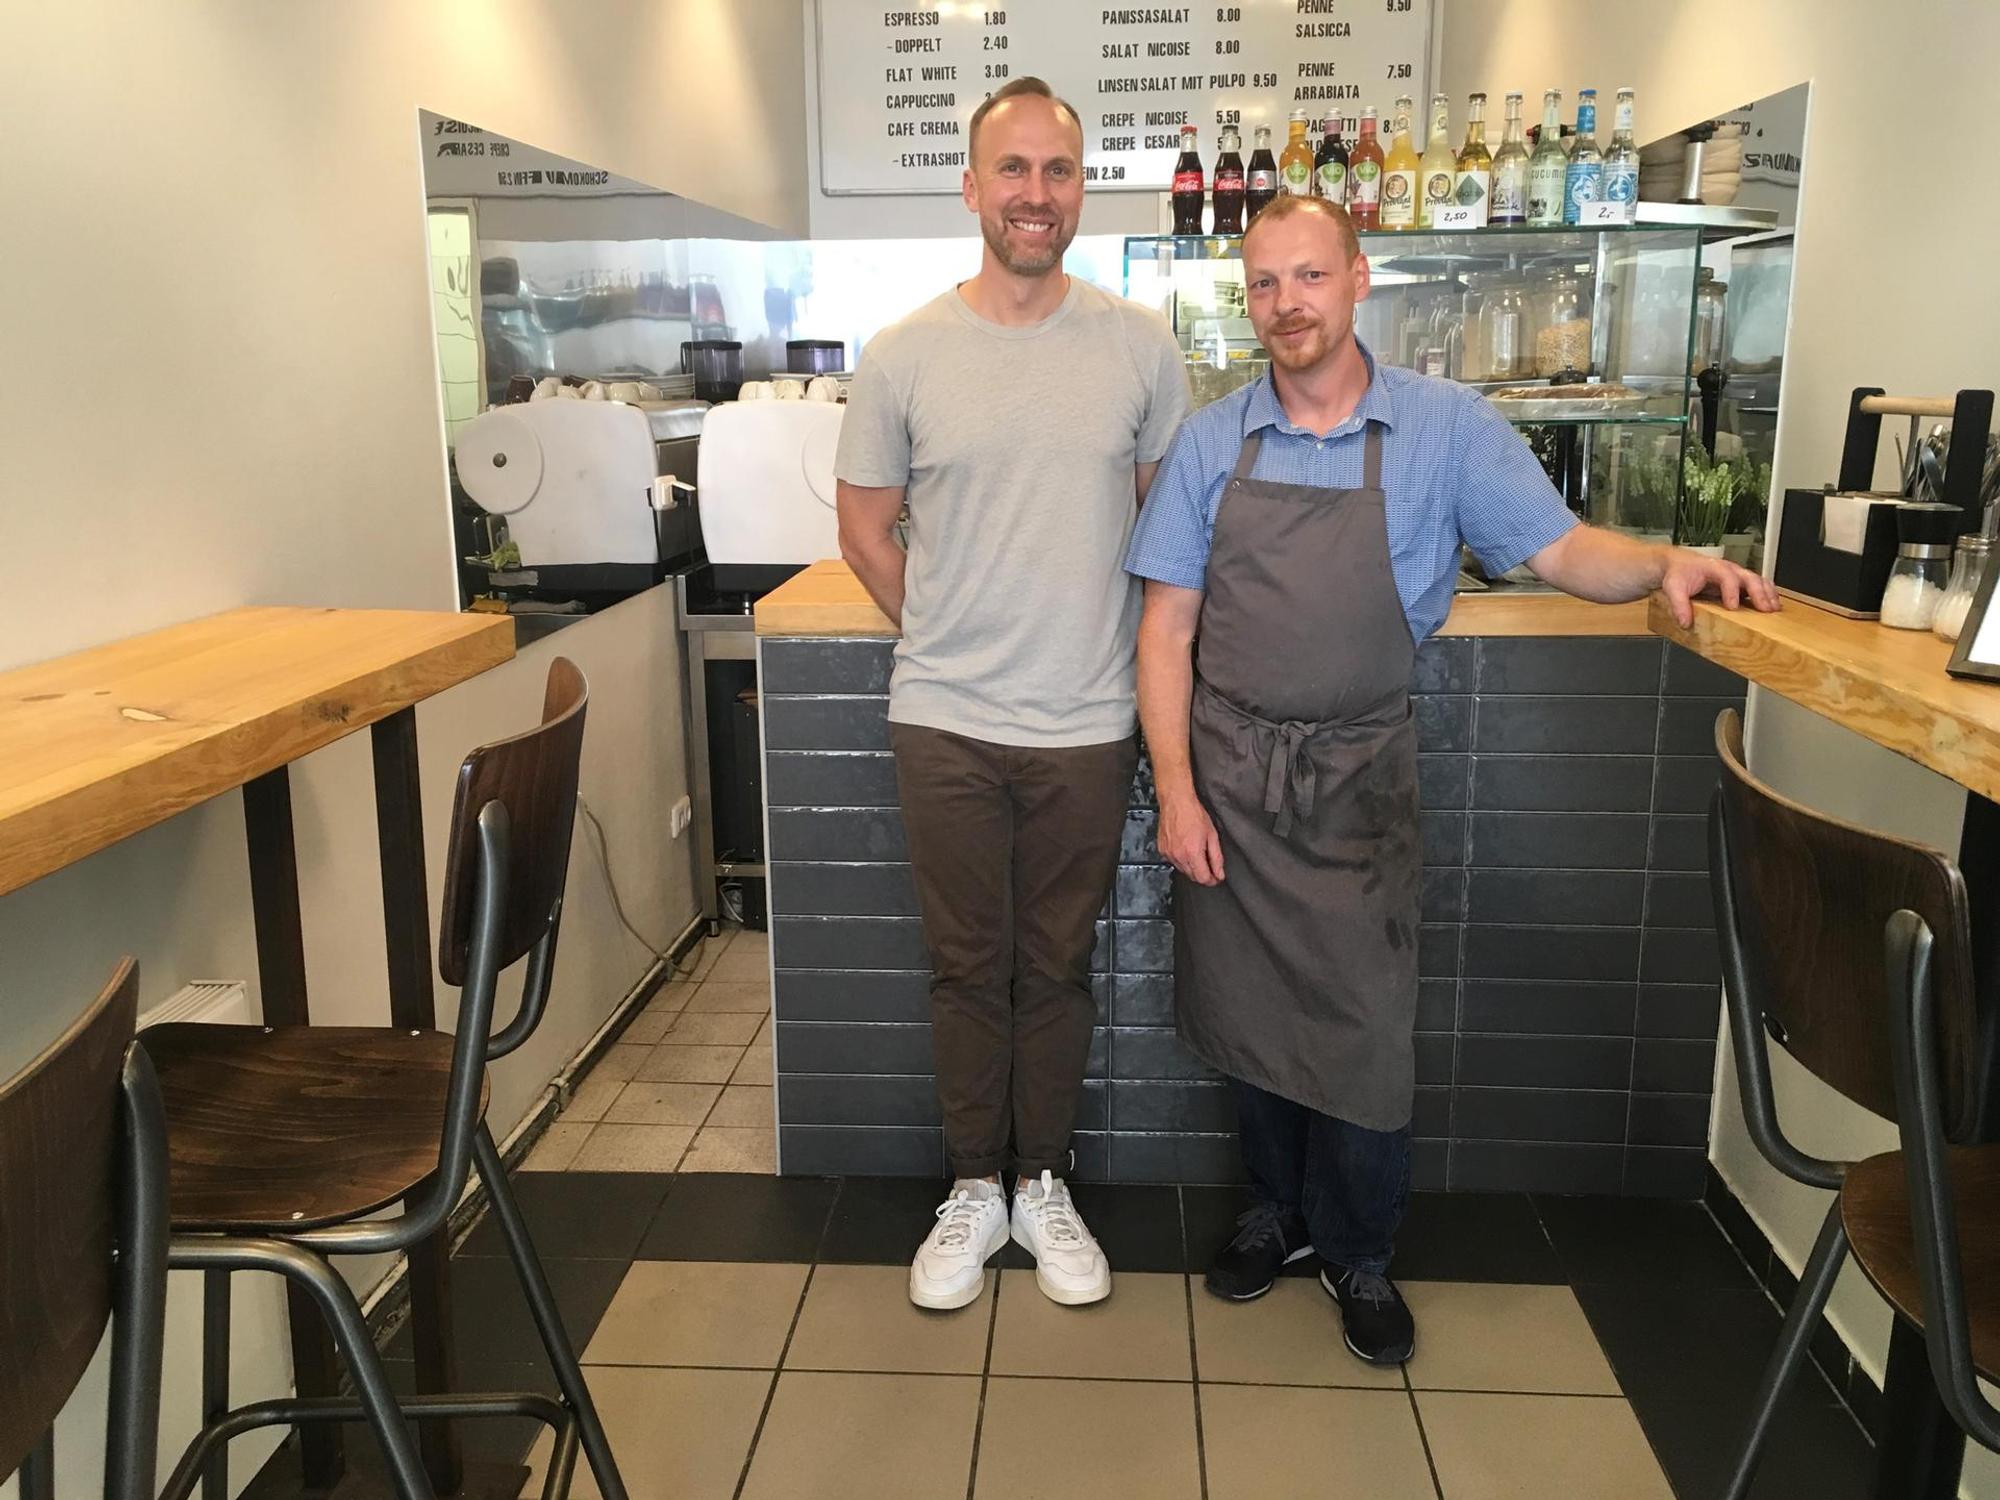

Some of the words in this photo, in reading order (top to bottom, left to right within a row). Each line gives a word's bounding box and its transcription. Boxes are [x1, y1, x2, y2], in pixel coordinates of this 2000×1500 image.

[1297, 0, 1334, 14] PENNE
[1387, 0, 1411, 12] 9.50
[884, 11, 940, 27] ESPRESSO
[984, 11, 1006, 26] 1.80
[1102, 8, 1190, 25] PANISSASALAT
[1216, 7, 1241, 23] 8.00
[1295, 22, 1351, 38] SALSICCA
[983, 35, 1008, 51] 2.40
[1102, 43, 1139, 59] SALAT
[1147, 41, 1191, 57] NICOISE
[1215, 39, 1240, 55] 8.00
[886, 68, 913, 82] FLAT
[921, 66, 957, 81] WHITE
[984, 64, 1009, 79] 3.00
[1298, 62, 1335, 77] PENNE
[1387, 63, 1412, 79] 7.50
[1181, 75, 1203, 90] MIT
[1209, 73, 1246, 89] PULPO
[1253, 73, 1278, 87] 9.50
[886, 92, 956, 109] CAPPUCCINO
[1294, 84, 1360, 101] ARRABIATA
[1102, 112, 1135, 127] CREPE
[1145, 111, 1188, 126] NICOISE
[1216, 110, 1241, 124] 5.50
[888, 122, 915, 137] CAFE
[920, 121, 960, 136] CREMA
[1102, 136, 1136, 151] CREPE
[1144, 134, 1181, 150] CESAR
[1101, 166, 1125, 180] 2.50
[1443, 211, 1468, 222] 2,50
